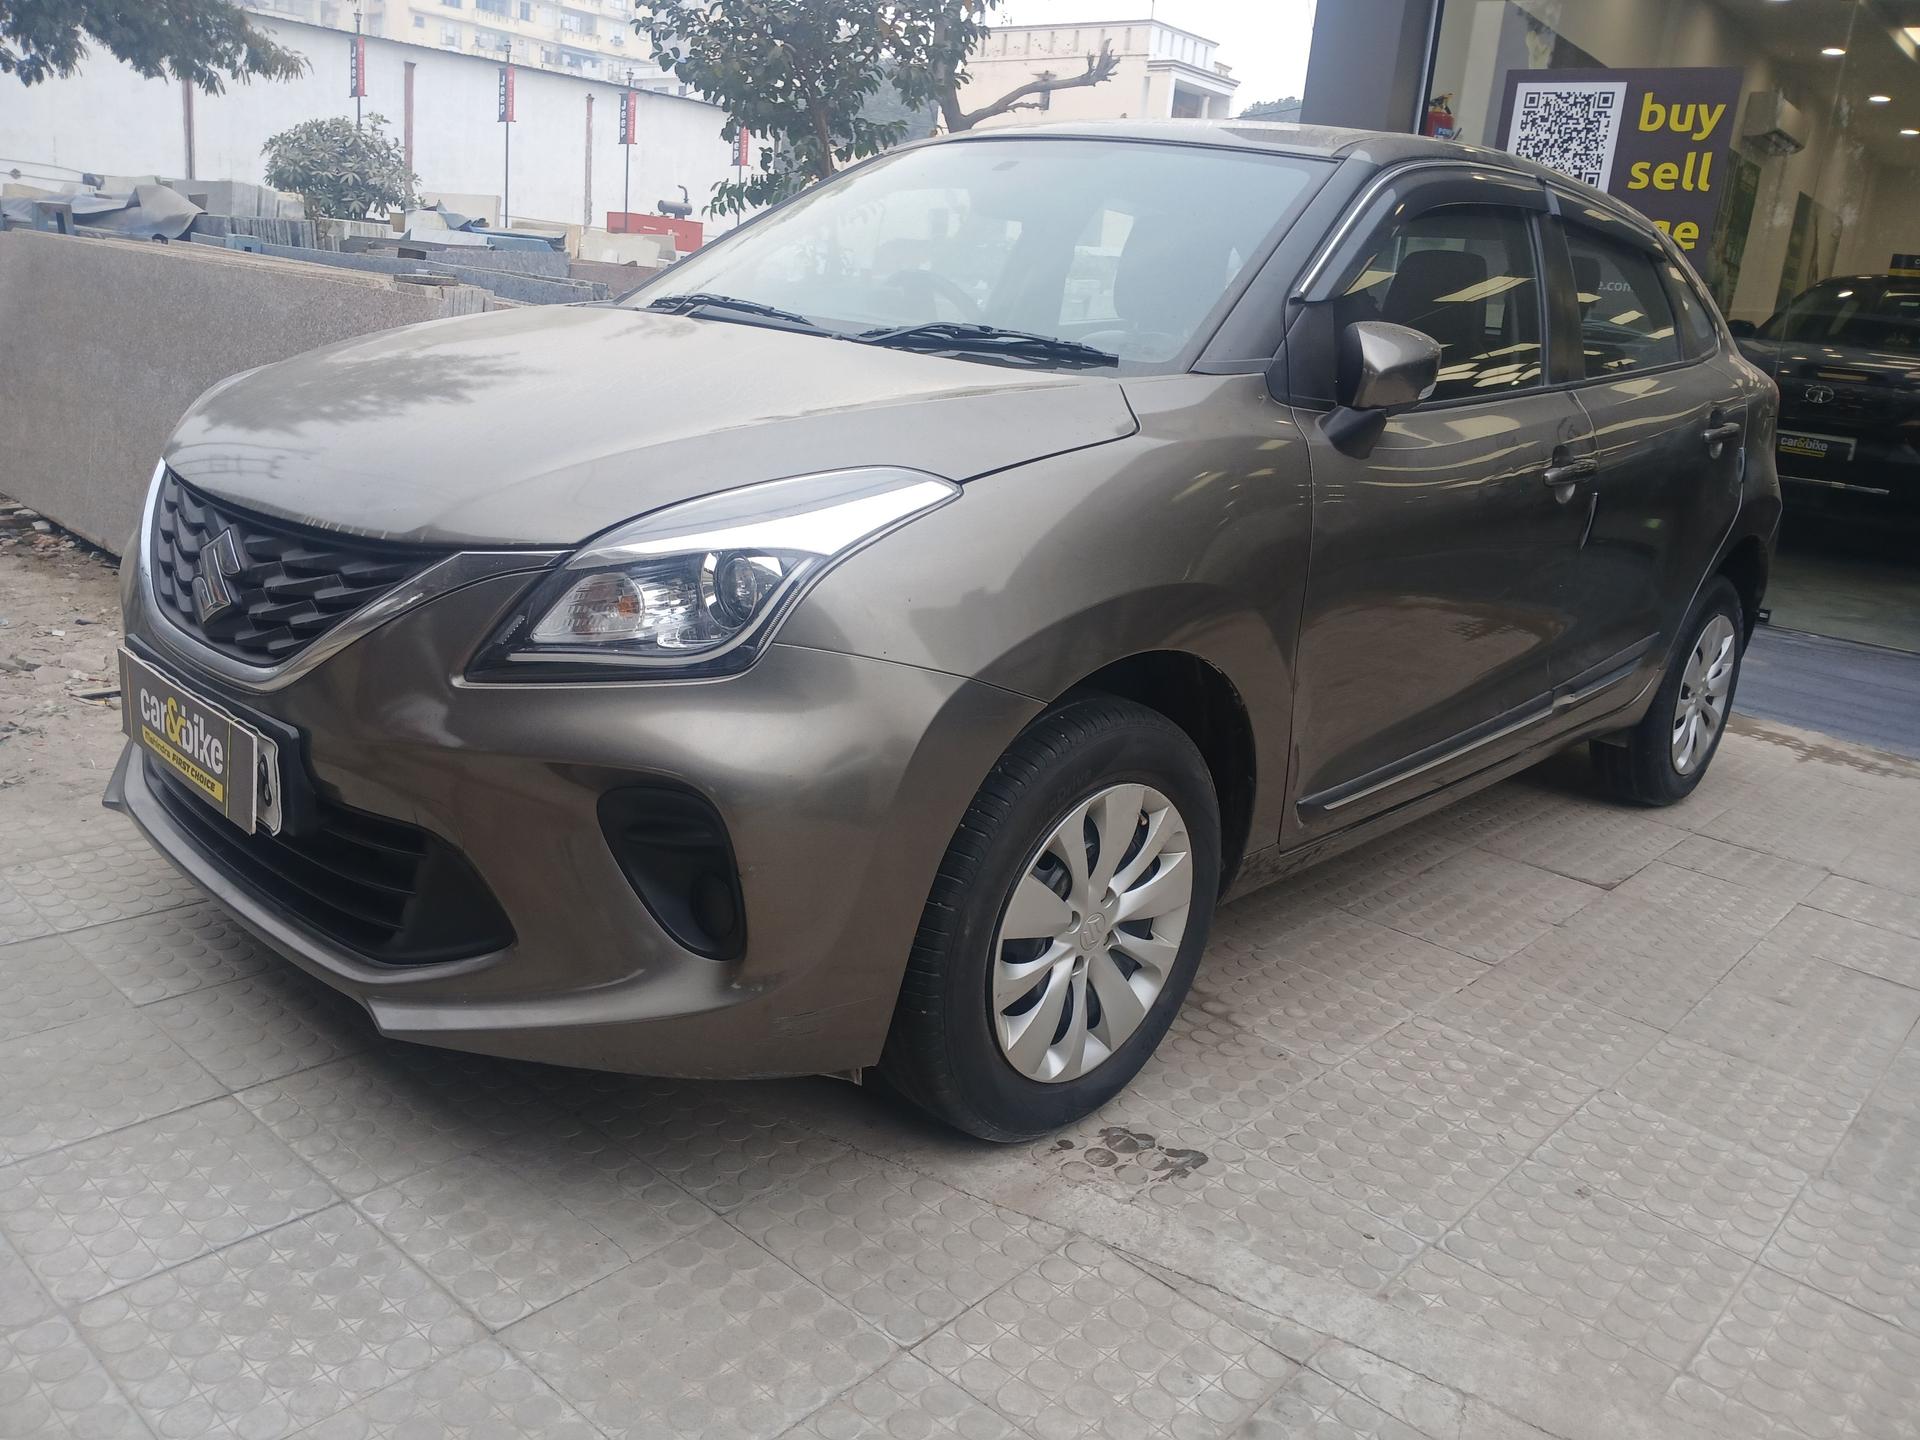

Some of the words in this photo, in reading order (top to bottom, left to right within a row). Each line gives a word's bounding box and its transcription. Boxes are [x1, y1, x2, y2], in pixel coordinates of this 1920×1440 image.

[1638, 92, 1726, 141] buy
[1627, 152, 1713, 192] sell
[140, 688, 224, 774] car&bike
[171, 752, 191, 773] FIRST
[190, 766, 216, 793] CHOICE
